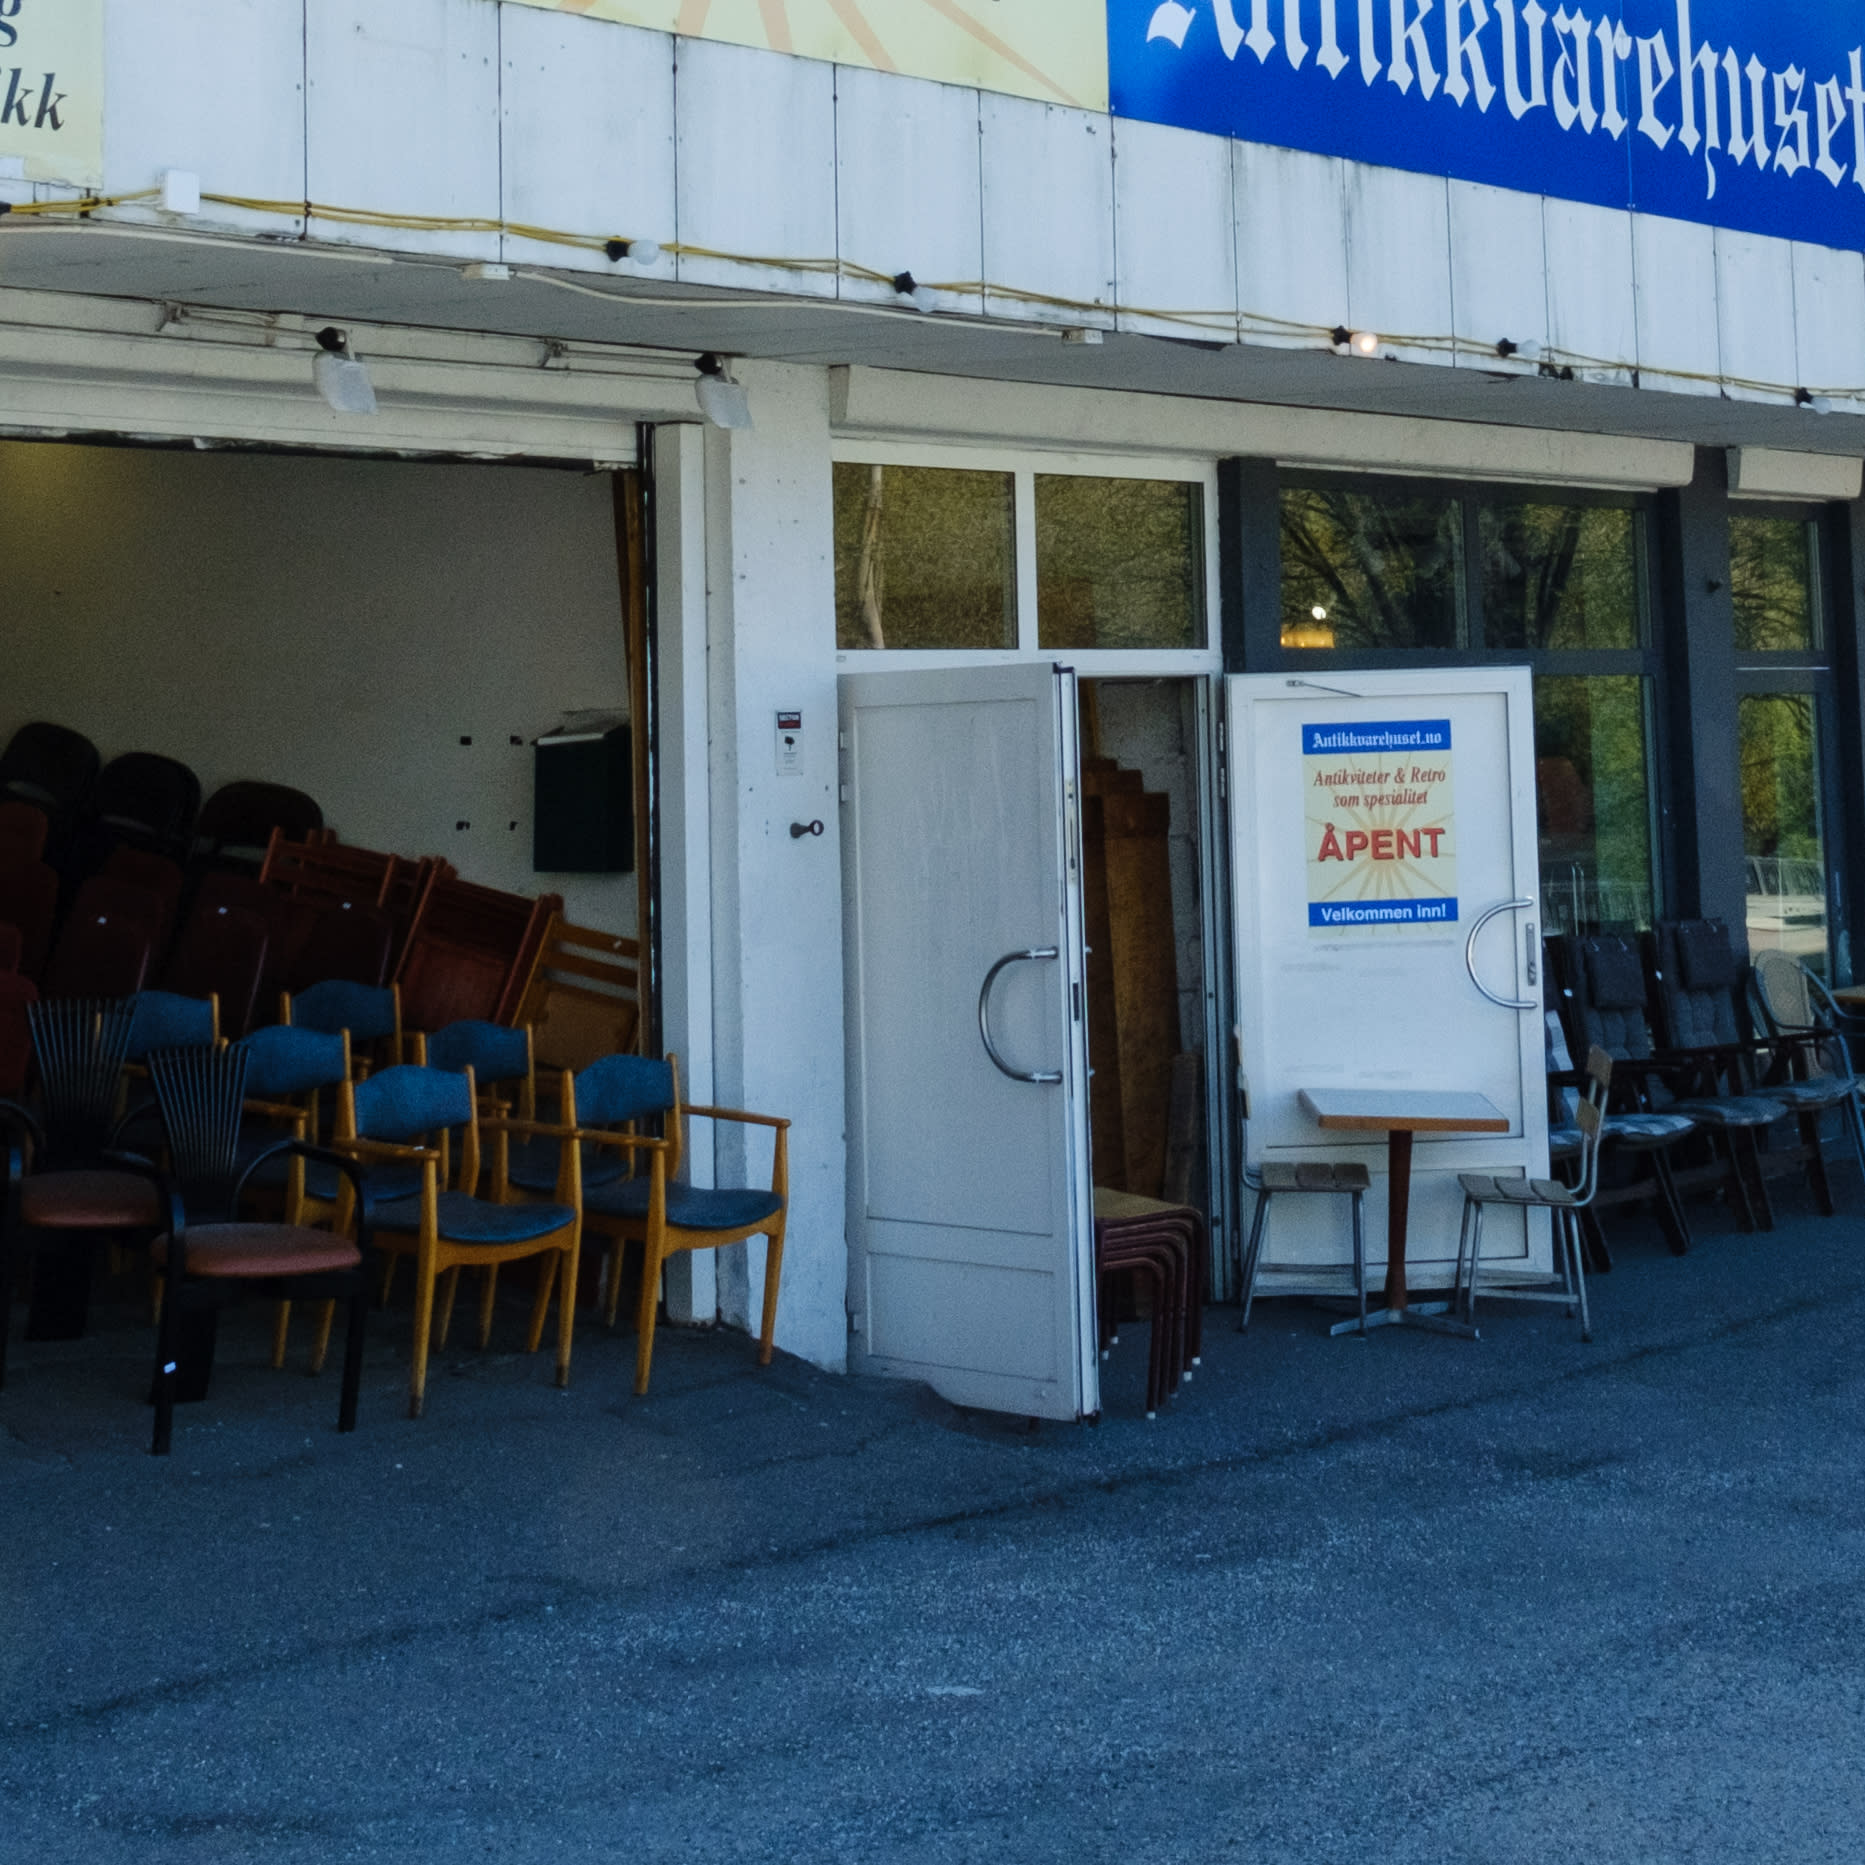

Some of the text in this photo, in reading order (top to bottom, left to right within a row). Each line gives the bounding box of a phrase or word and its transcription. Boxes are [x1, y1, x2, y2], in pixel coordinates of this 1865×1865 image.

[1312, 730, 1443, 749] Antikkvarehuset.no
[1313, 766, 1446, 786] Antikviteter & Retro
[1333, 788, 1429, 811] som spesialitet
[1317, 822, 1446, 862] ÅPENT
[1321, 903, 1447, 922] Velkommen inn!
